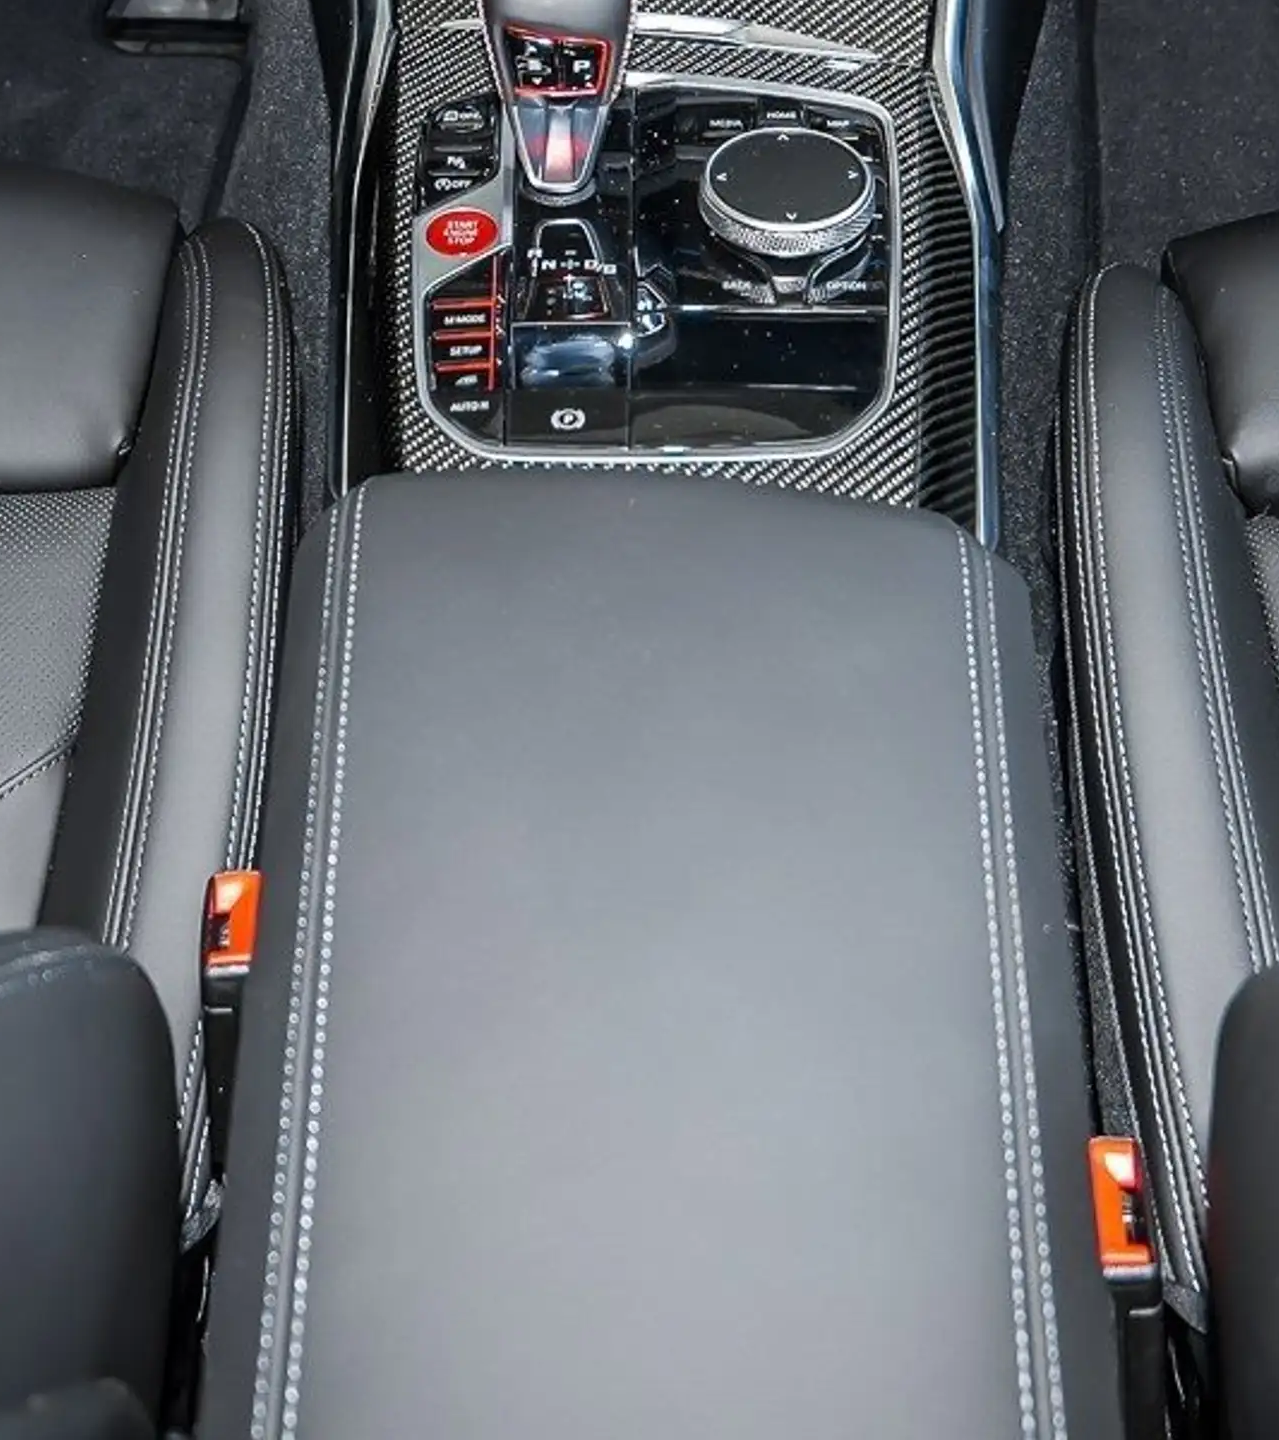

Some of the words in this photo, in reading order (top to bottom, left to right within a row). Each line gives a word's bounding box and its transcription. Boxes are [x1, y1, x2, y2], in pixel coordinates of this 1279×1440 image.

[573, 60, 591, 73] P
[766, 111, 797, 119] HOME
[709, 119, 743, 129] MEDIA
[447, 220, 479, 229] START
[447, 237, 476, 245] STOP
[541, 259, 557, 271] N
[826, 280, 867, 291] OPTION
[449, 345, 483, 357] SETUP
